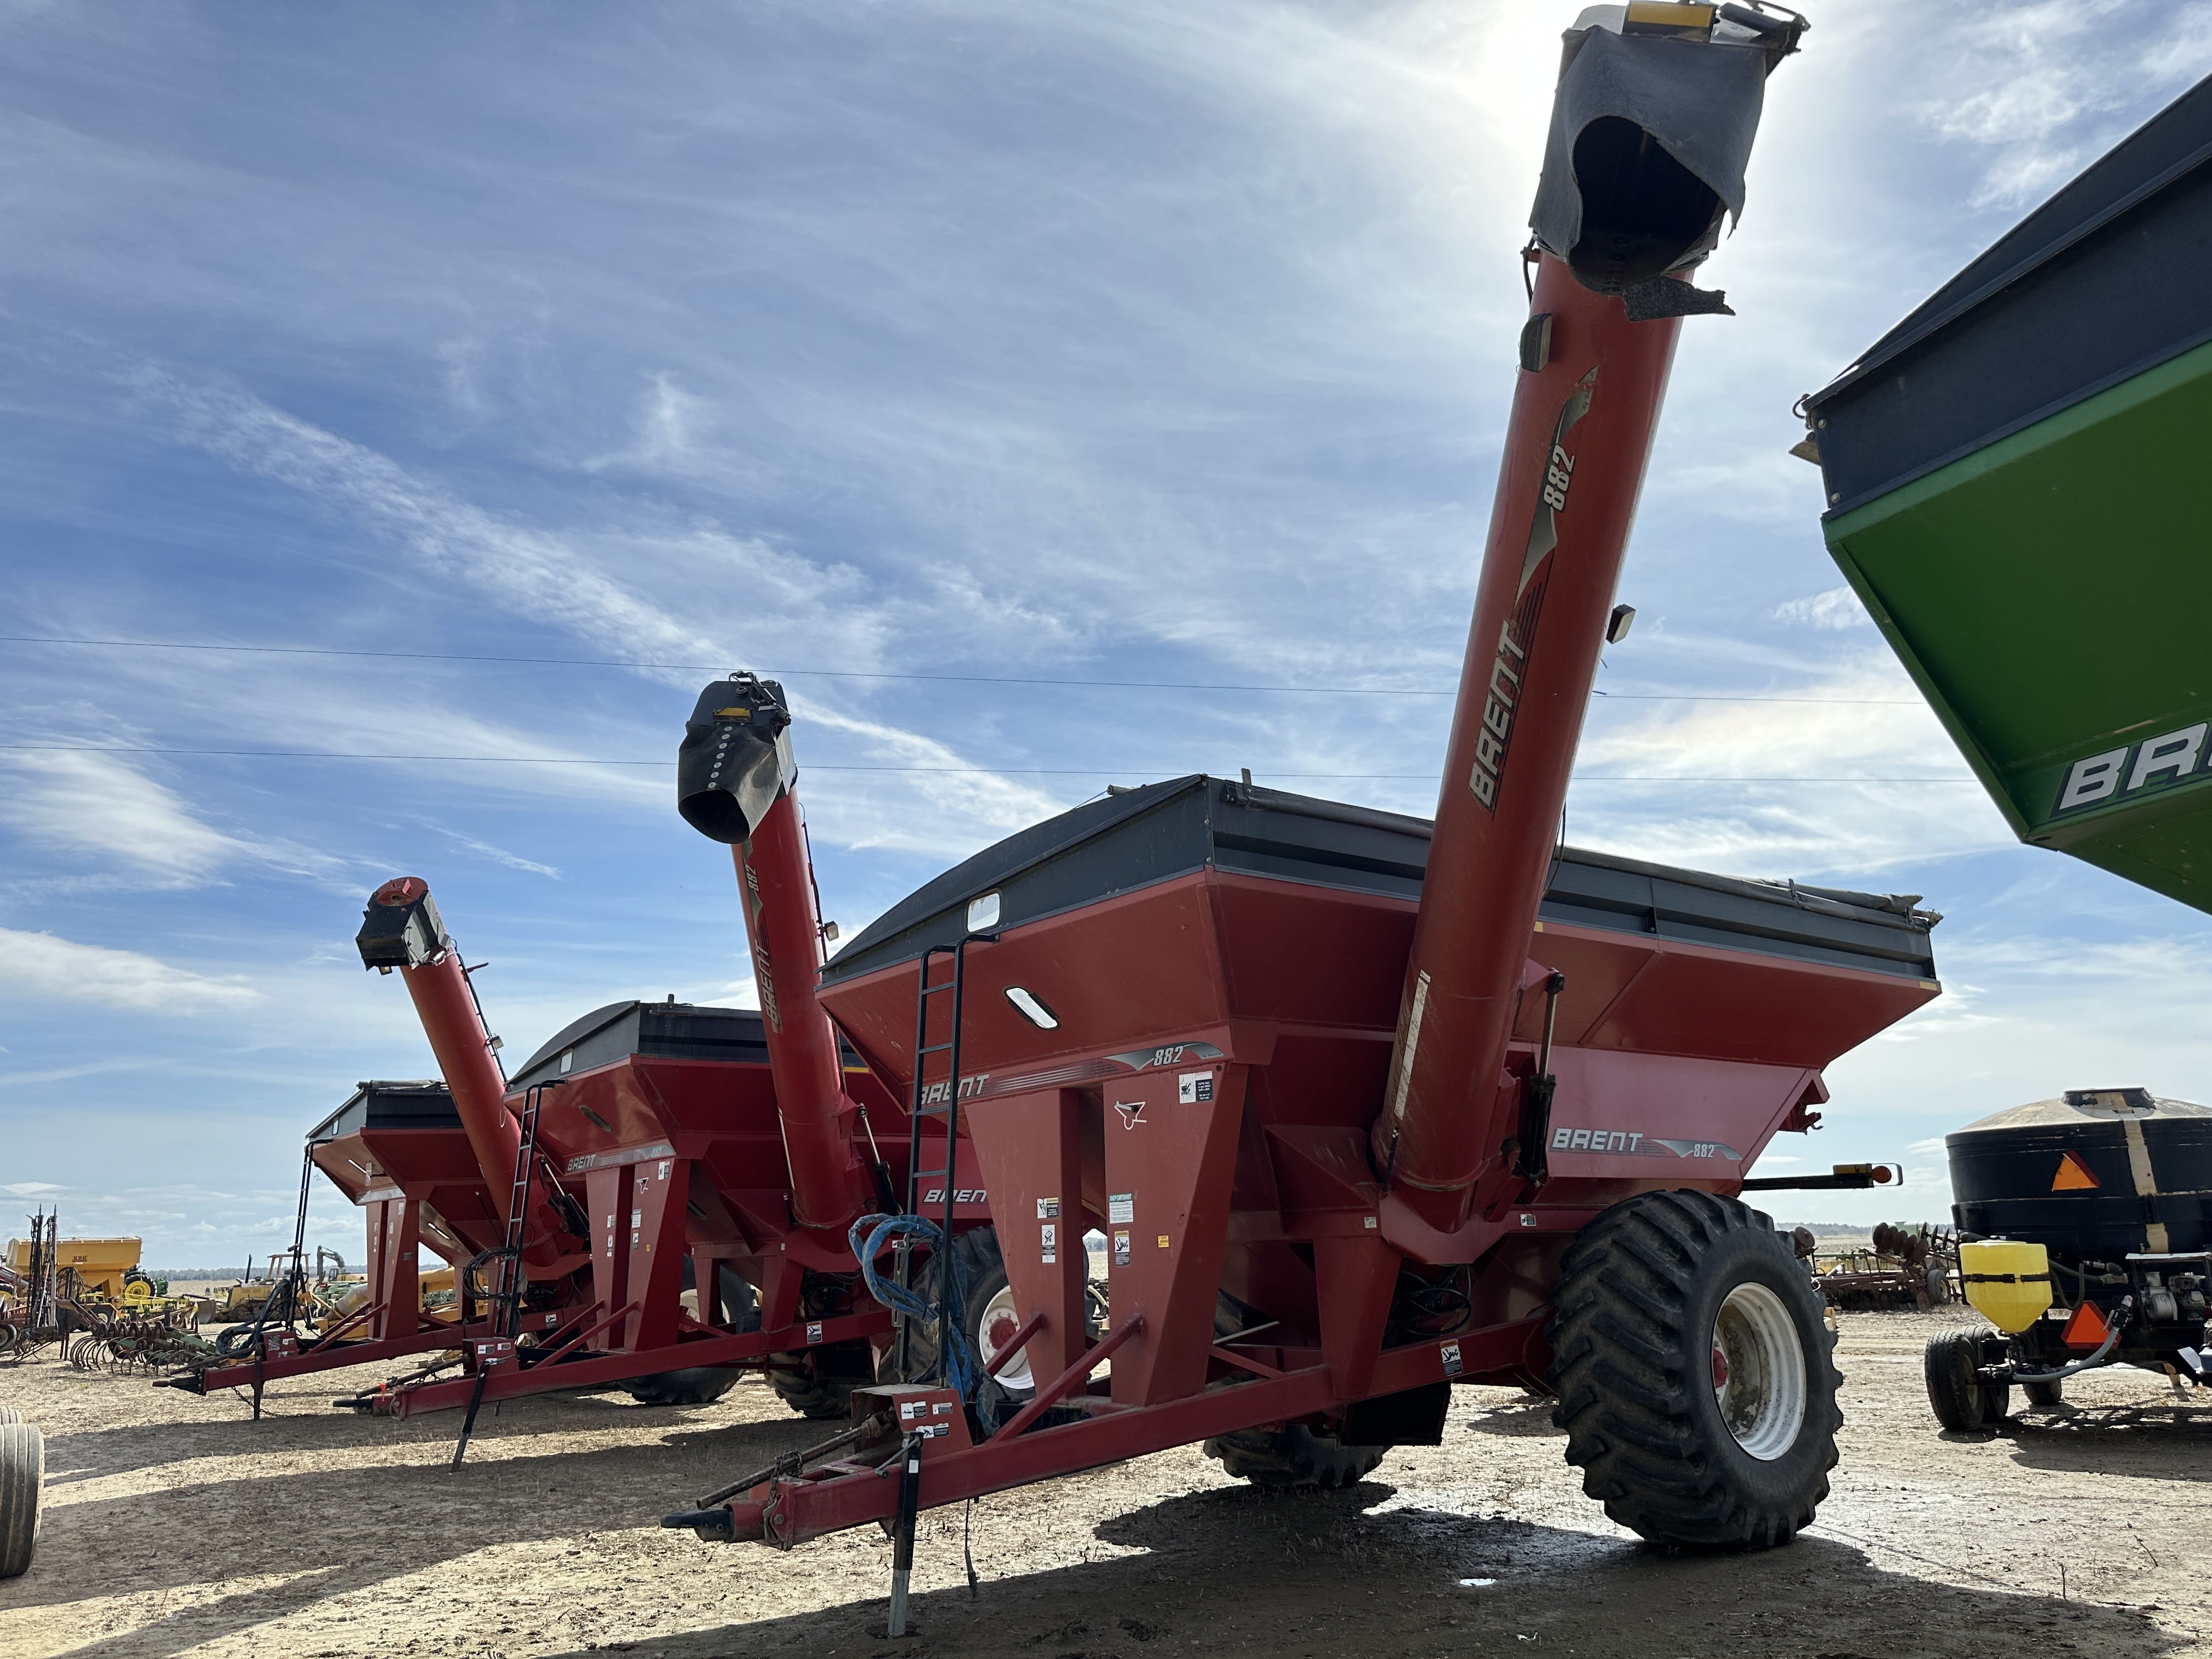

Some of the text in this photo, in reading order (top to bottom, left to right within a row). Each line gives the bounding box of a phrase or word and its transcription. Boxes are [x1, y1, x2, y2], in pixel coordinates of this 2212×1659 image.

[1470, 444, 1575, 806] BRENT 882
[746, 864, 779, 1025] BRENT 882
[1153, 1046, 1183, 1066] 882
[1552, 1127, 1714, 1158] BRENT 882
[567, 1154, 596, 1171] BRENT
[1109, 1194, 1132, 1202] IMPORTANT
